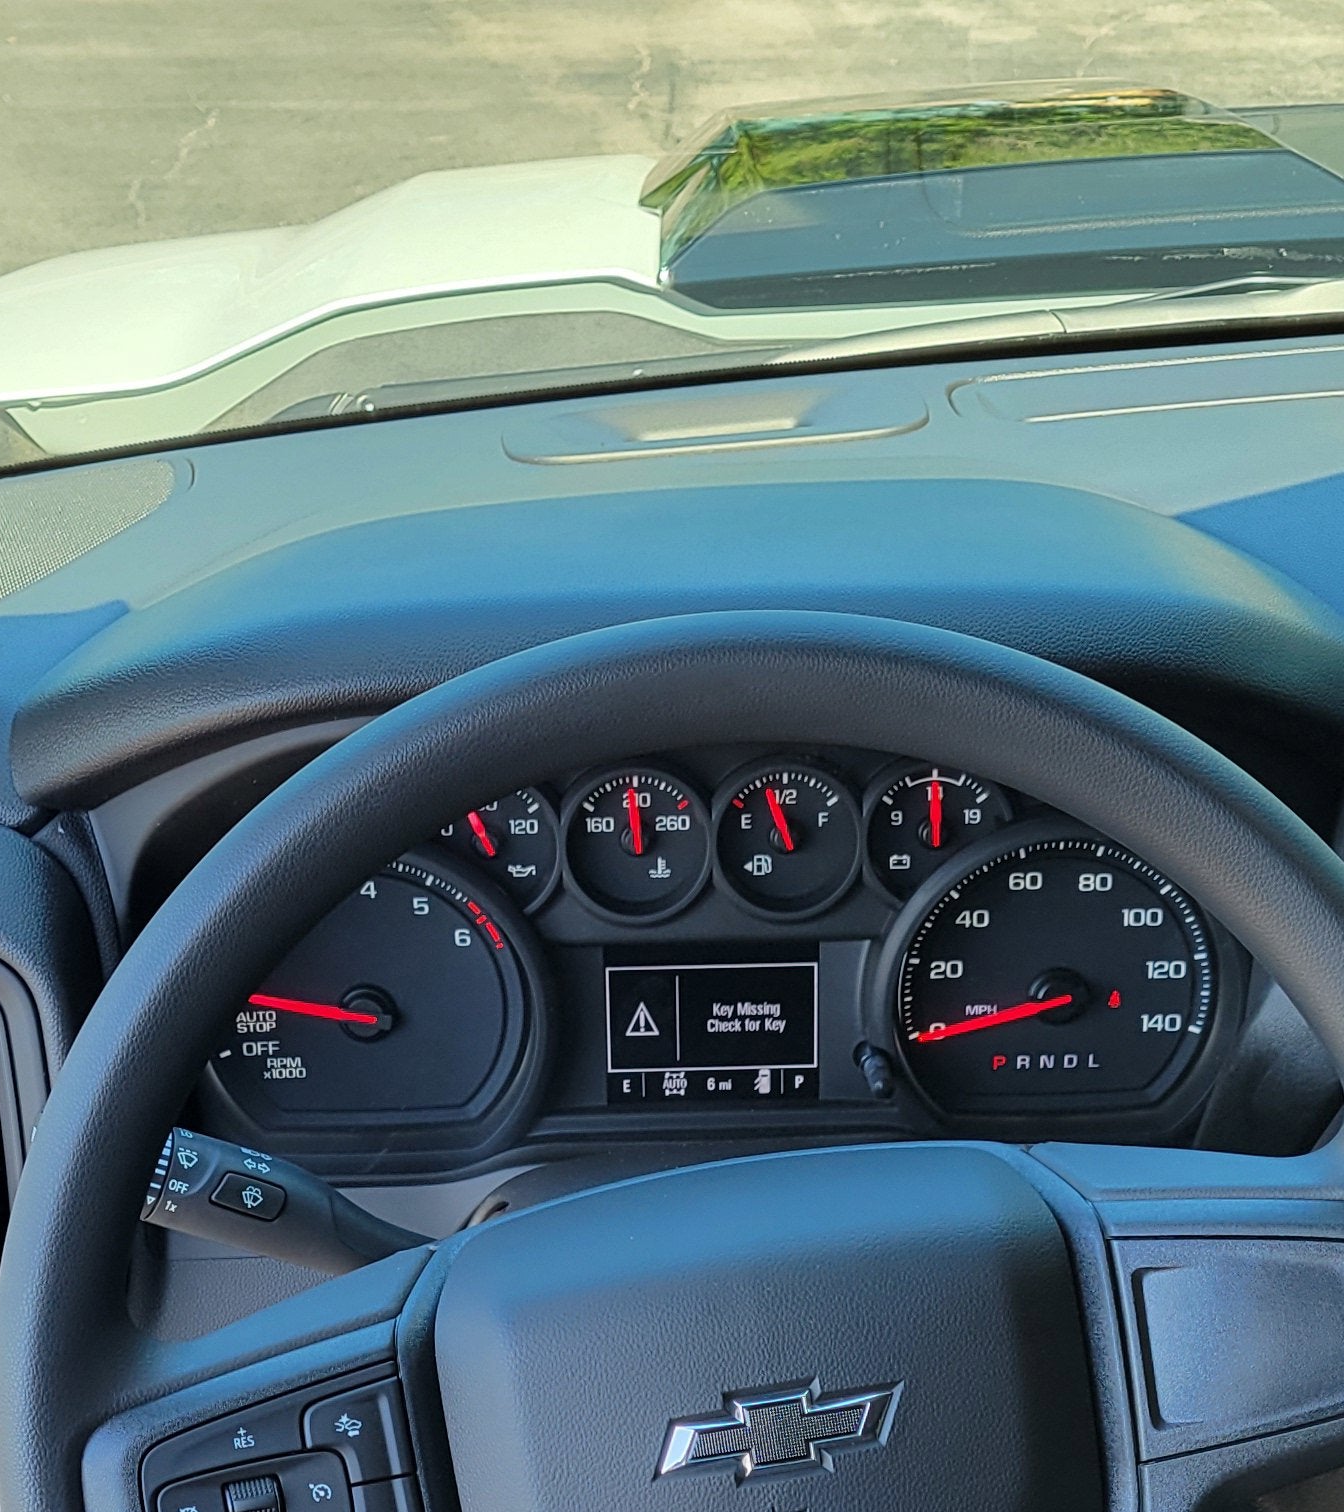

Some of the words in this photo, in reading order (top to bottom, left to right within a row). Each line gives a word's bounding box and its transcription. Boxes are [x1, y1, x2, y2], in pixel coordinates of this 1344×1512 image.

[774, 789, 797, 804] 1/2
[655, 816, 690, 832] 260
[741, 814, 752, 829] E
[818, 812, 829, 827] F
[891, 811, 903, 826] 9
[963, 808, 981, 824] 19
[509, 819, 539, 835] 120
[585, 817, 615, 833] 160
[1009, 872, 1043, 890] 60
[1078, 873, 1113, 892] 80
[360, 880, 378, 899] 4
[413, 897, 430, 915] 5
[956, 909, 990, 928] 40
[1122, 908, 1164, 927] 100
[454, 929, 471, 947] 6
[929, 960, 963, 979] 20
[1146, 961, 1187, 979] 120
[235, 1010, 276, 1023] AUTO
[712, 1002, 735, 1018] Key
[737, 1001, 780, 1018] Missing
[965, 1004, 997, 1016] MPH
[236, 1022, 276, 1034] STOP
[707, 1018, 742, 1033] Check
[745, 1017, 760, 1032] for
[764, 1017, 786, 1034] Key
[1141, 1013, 1182, 1032] 140
[242, 1041, 280, 1057] OFF
[266, 1057, 302, 1069] RPM
[992, 1055, 1006, 1070] P
[1016, 1055, 1031, 1069] R
[1039, 1054, 1055, 1069] N
[1063, 1054, 1078, 1068] D
[1088, 1053, 1100, 1067] L
[263, 1067, 307, 1080] x1000
[623, 1079, 631, 1093] E
[663, 1078, 688, 1090] AUTO
[707, 1078, 715, 1091] 6
[719, 1078, 732, 1091] mi
[794, 1075, 804, 1089] P
[168, 1179, 189, 1195] OFF
[233, 1435, 255, 1450] RES
